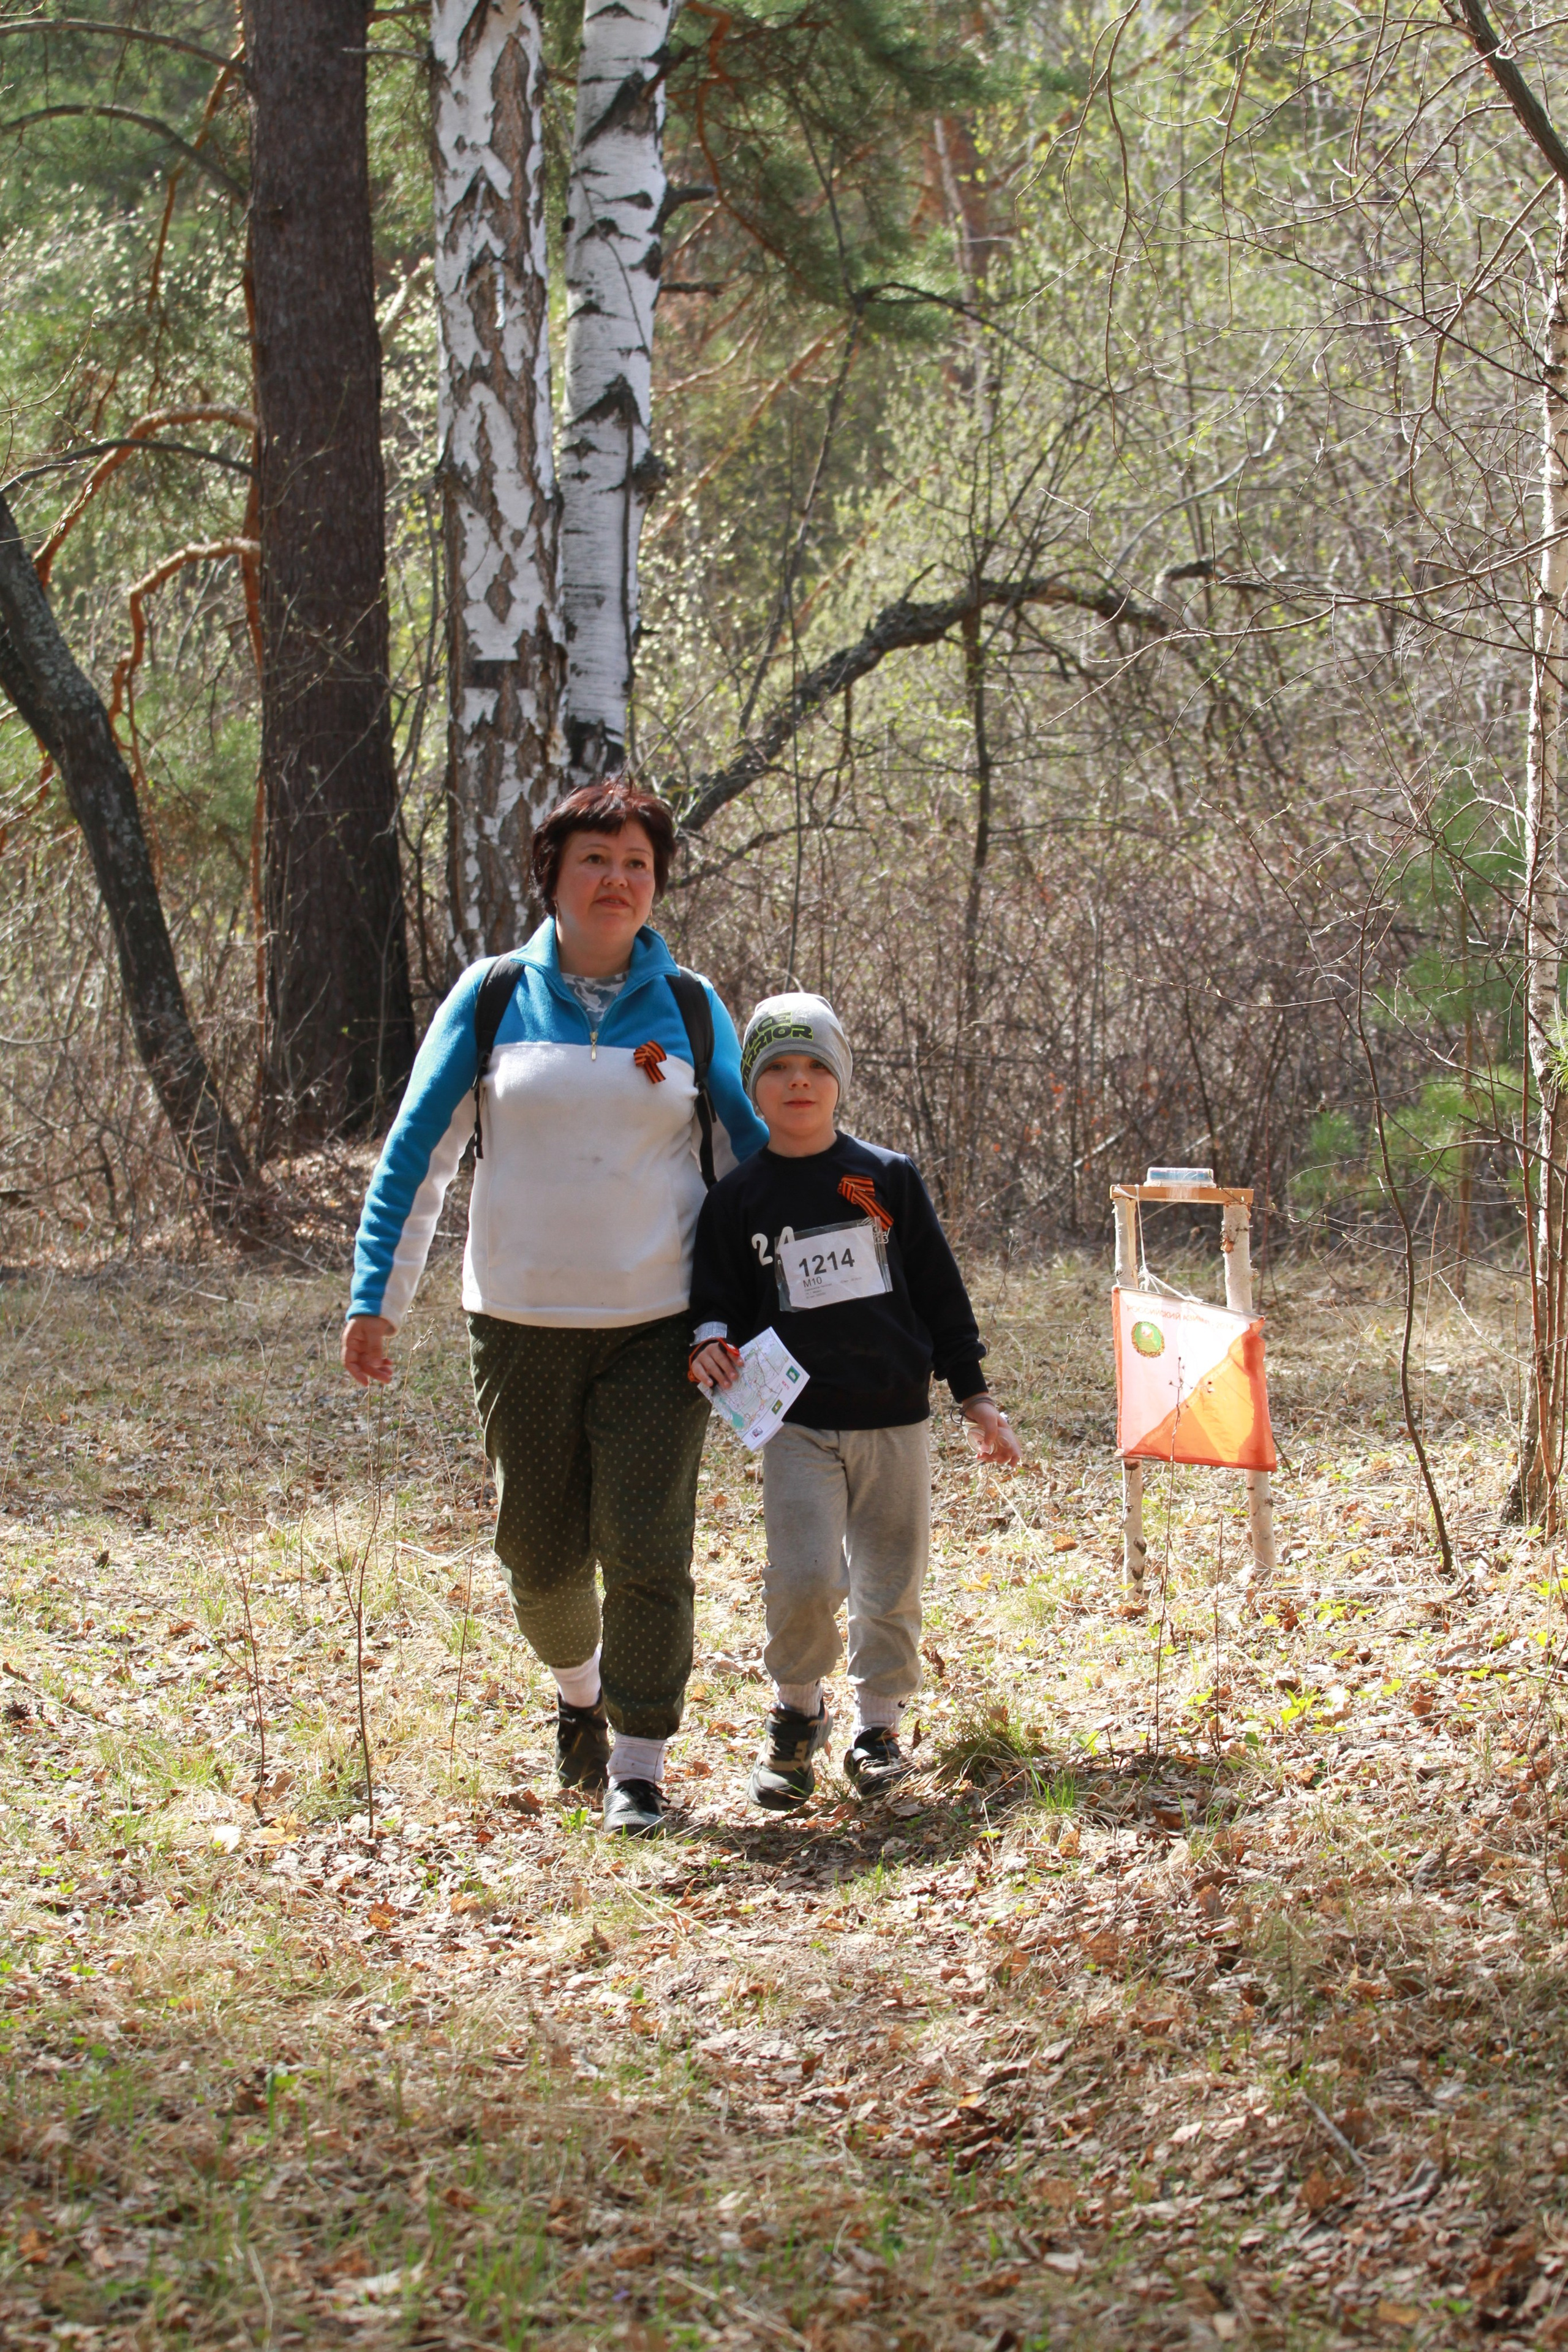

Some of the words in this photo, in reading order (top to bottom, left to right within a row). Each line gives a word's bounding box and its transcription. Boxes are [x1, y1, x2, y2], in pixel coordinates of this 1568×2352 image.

[799, 1248, 856, 1277] 1214
[802, 1276, 823, 1288] M10
[1126, 1304, 1182, 1321] РОССИЙСКИЙ
